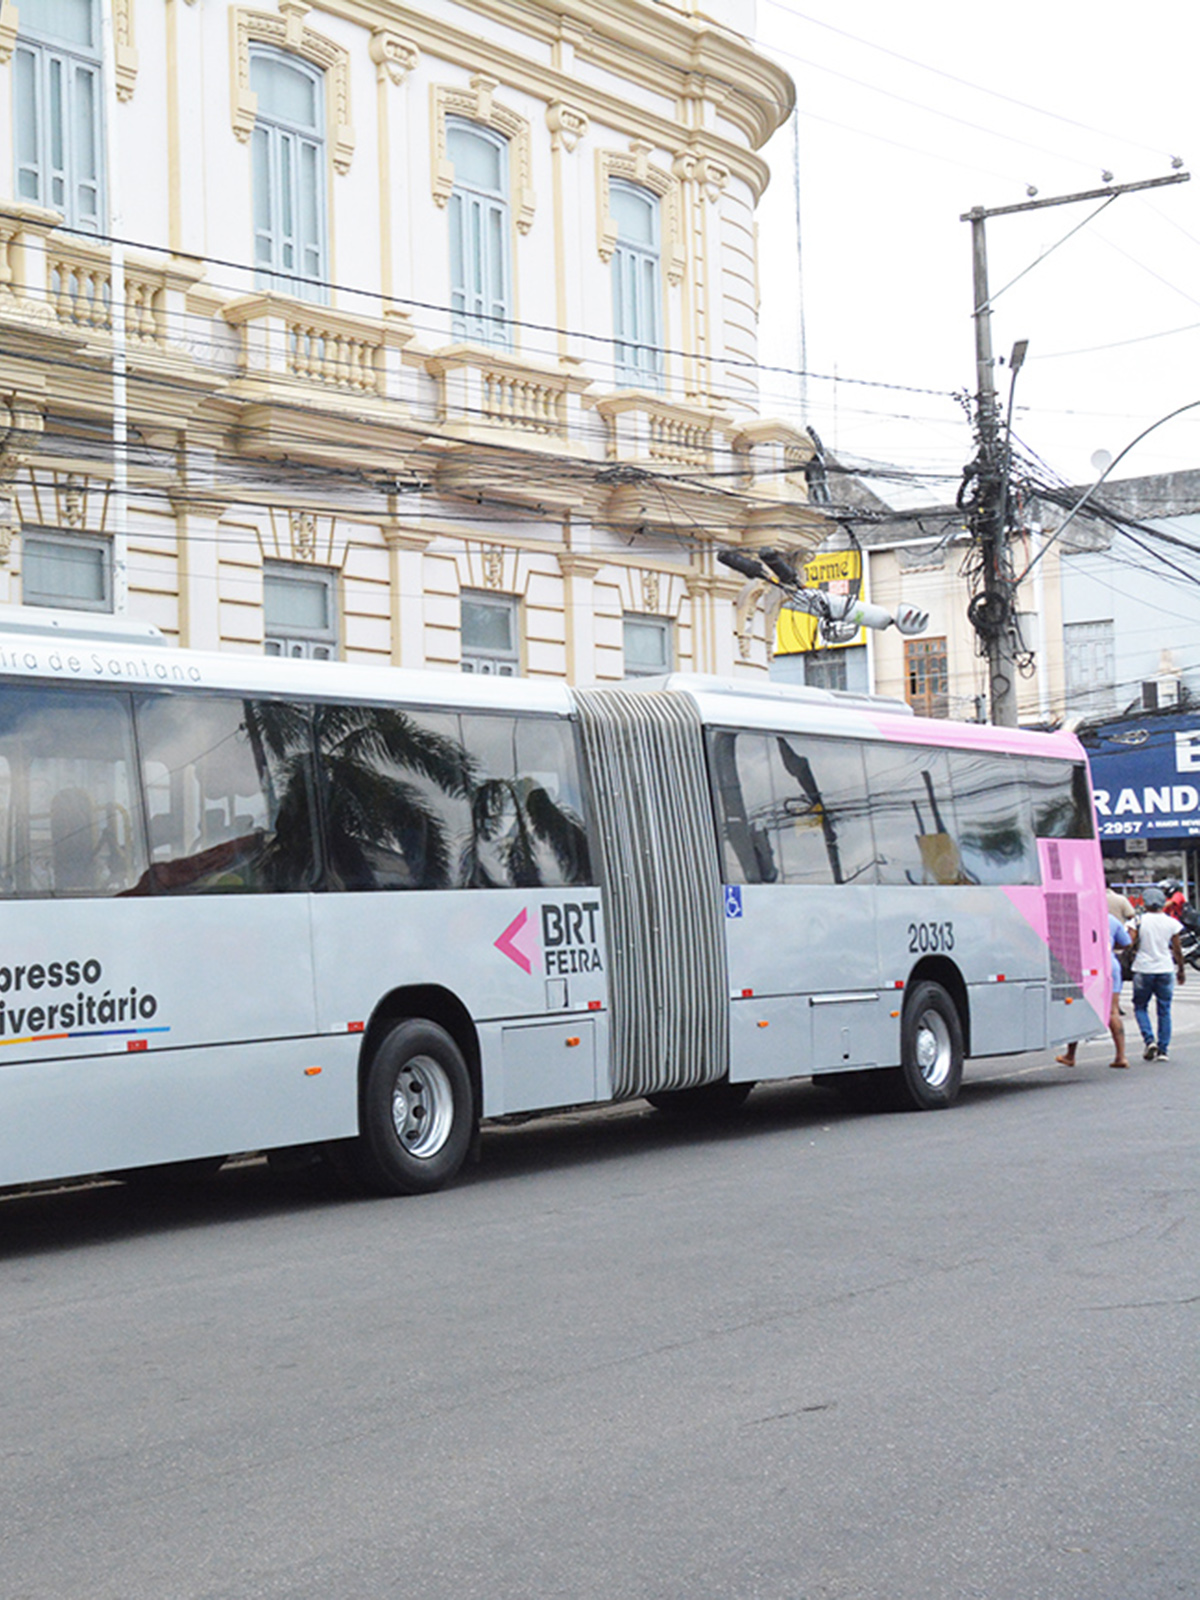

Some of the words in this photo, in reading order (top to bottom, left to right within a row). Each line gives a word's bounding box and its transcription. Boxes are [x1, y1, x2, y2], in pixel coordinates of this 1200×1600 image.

[48, 651, 81, 673] de
[90, 653, 201, 682] Santana
[542, 902, 599, 946] BRT
[908, 922, 955, 953] 20313
[545, 948, 603, 976] FEIRA
